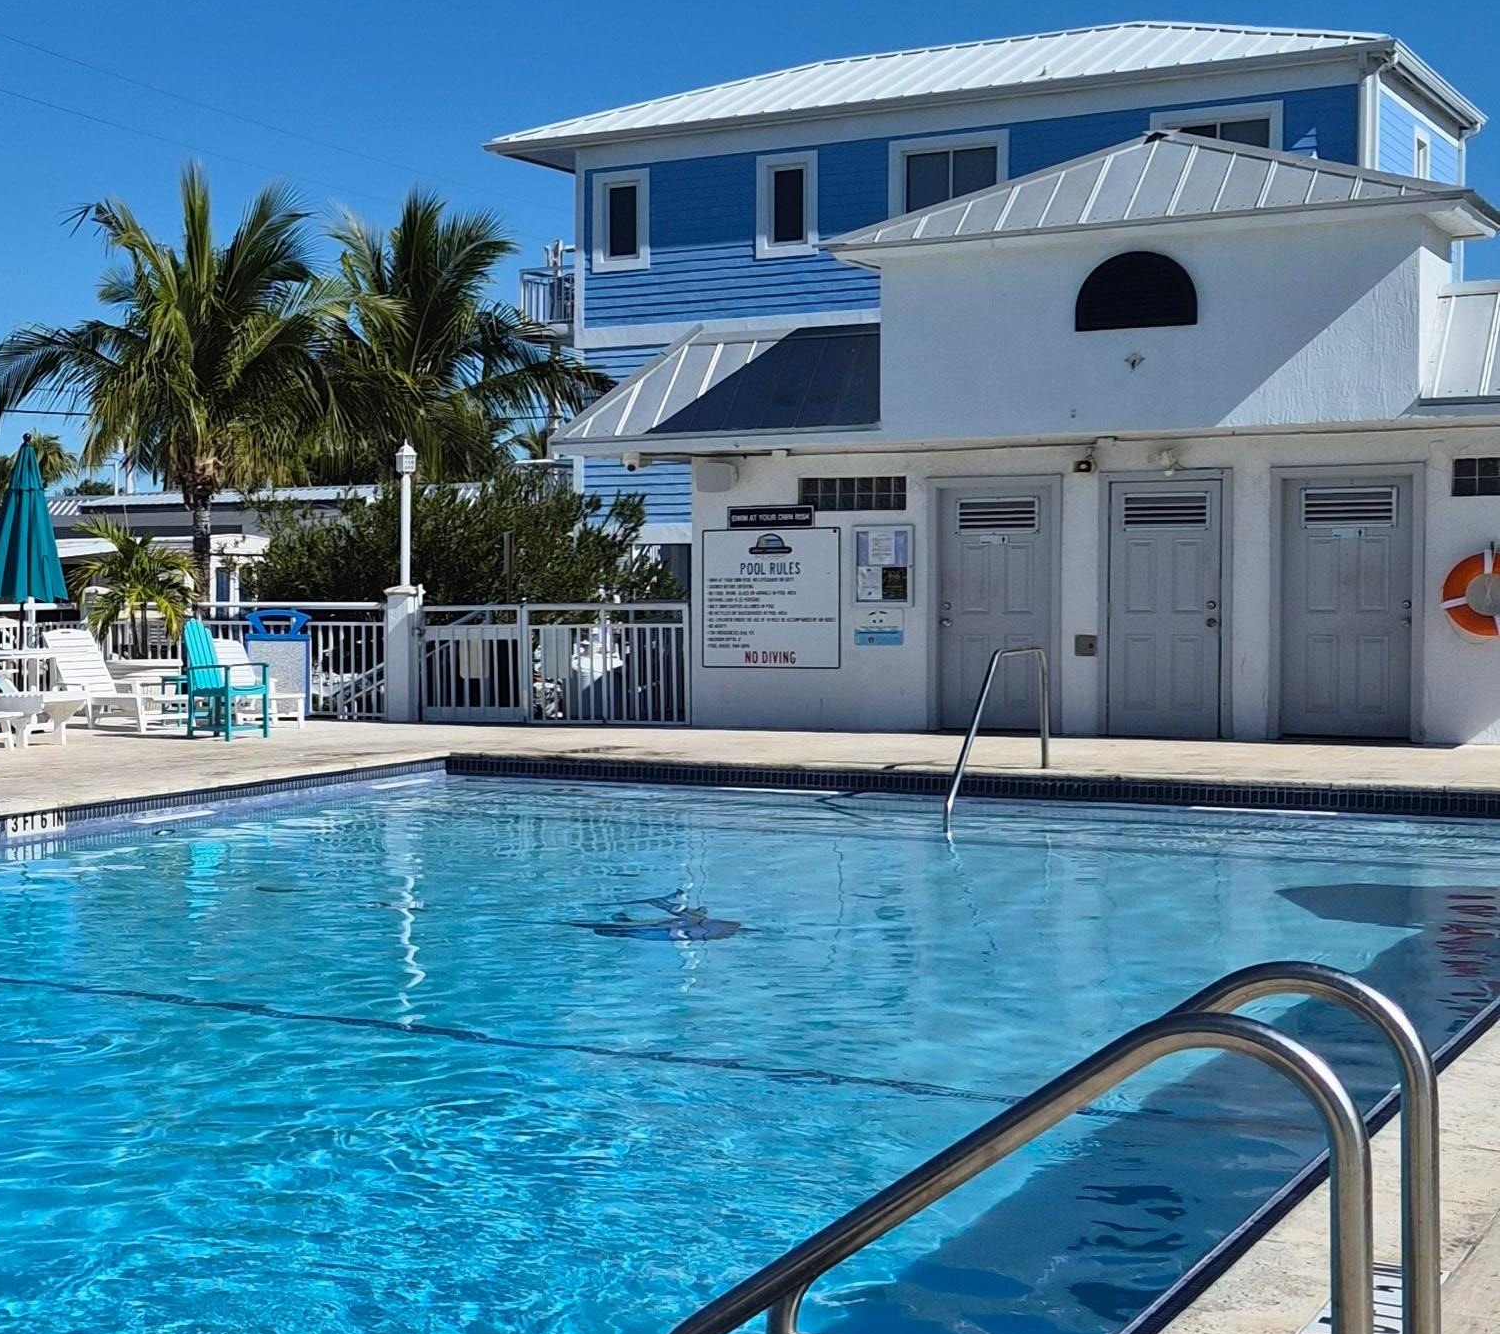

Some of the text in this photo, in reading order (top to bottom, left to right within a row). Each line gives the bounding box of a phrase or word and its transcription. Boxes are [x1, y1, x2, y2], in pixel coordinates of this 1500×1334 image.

[740, 562, 801, 575] POOL RULES
[744, 650, 796, 664] NO DIVING
[11, 809, 64, 833] 3 FT 6 IN
